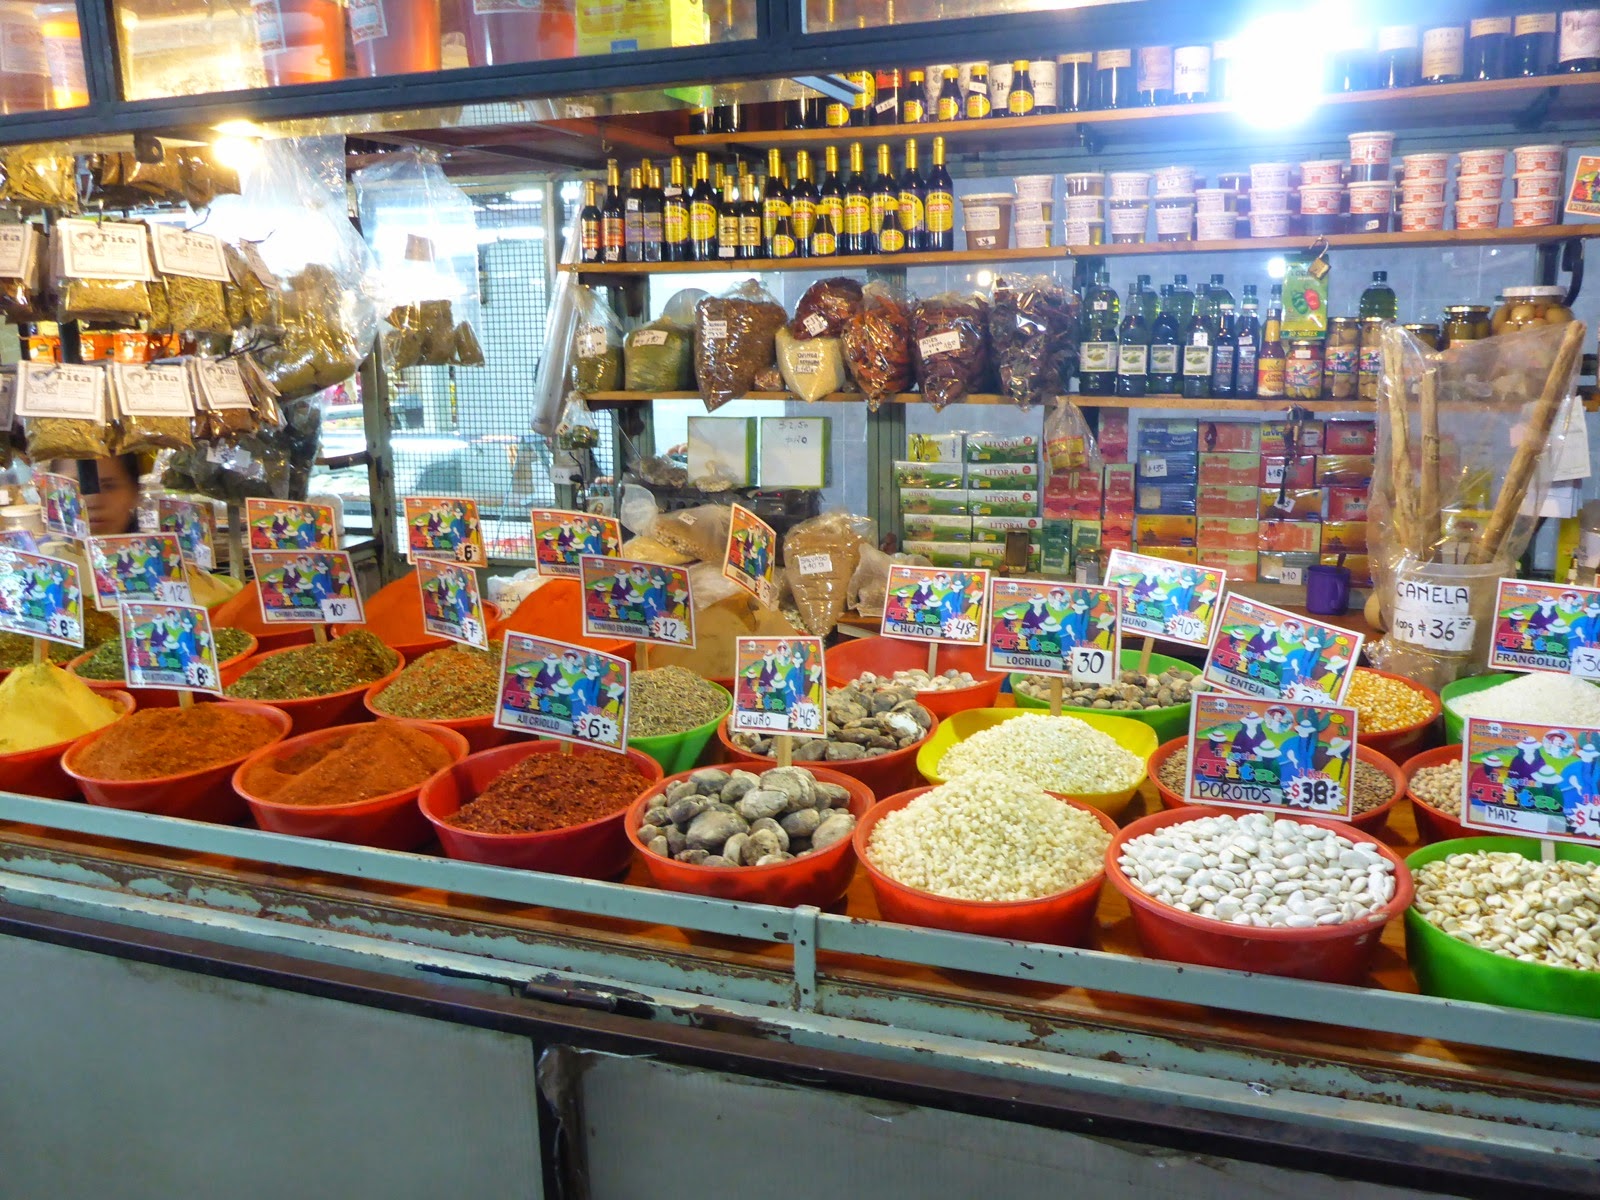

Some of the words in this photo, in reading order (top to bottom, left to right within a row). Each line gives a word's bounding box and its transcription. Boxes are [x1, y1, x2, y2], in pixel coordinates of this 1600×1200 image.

[99, 233, 137, 244] Tita
[183, 237, 214, 250] Tita
[55, 371, 92, 383] Tita
[146, 372, 179, 382] Tita
[1396, 582, 1469, 604] CANELA
[993, 633, 1062, 655] Tita
[1497, 632, 1568, 655] Tita
[1006, 656, 1052, 668] LOCRILLO
[1077, 651, 1104, 674] 30
[1211, 647, 1281, 686] Tita
[1496, 652, 1567, 668] FRANGOLLO
[1224, 674, 1266, 697] LENTEJA
[529, 715, 560, 730] CRIOLLO
[740, 712, 771, 727] CHUÑO
[1197, 757, 1281, 786] Tita
[1198, 781, 1272, 804] POROTOS
[1471, 782, 1562, 813] Tita
[1486, 805, 1519, 824] MAIZ
